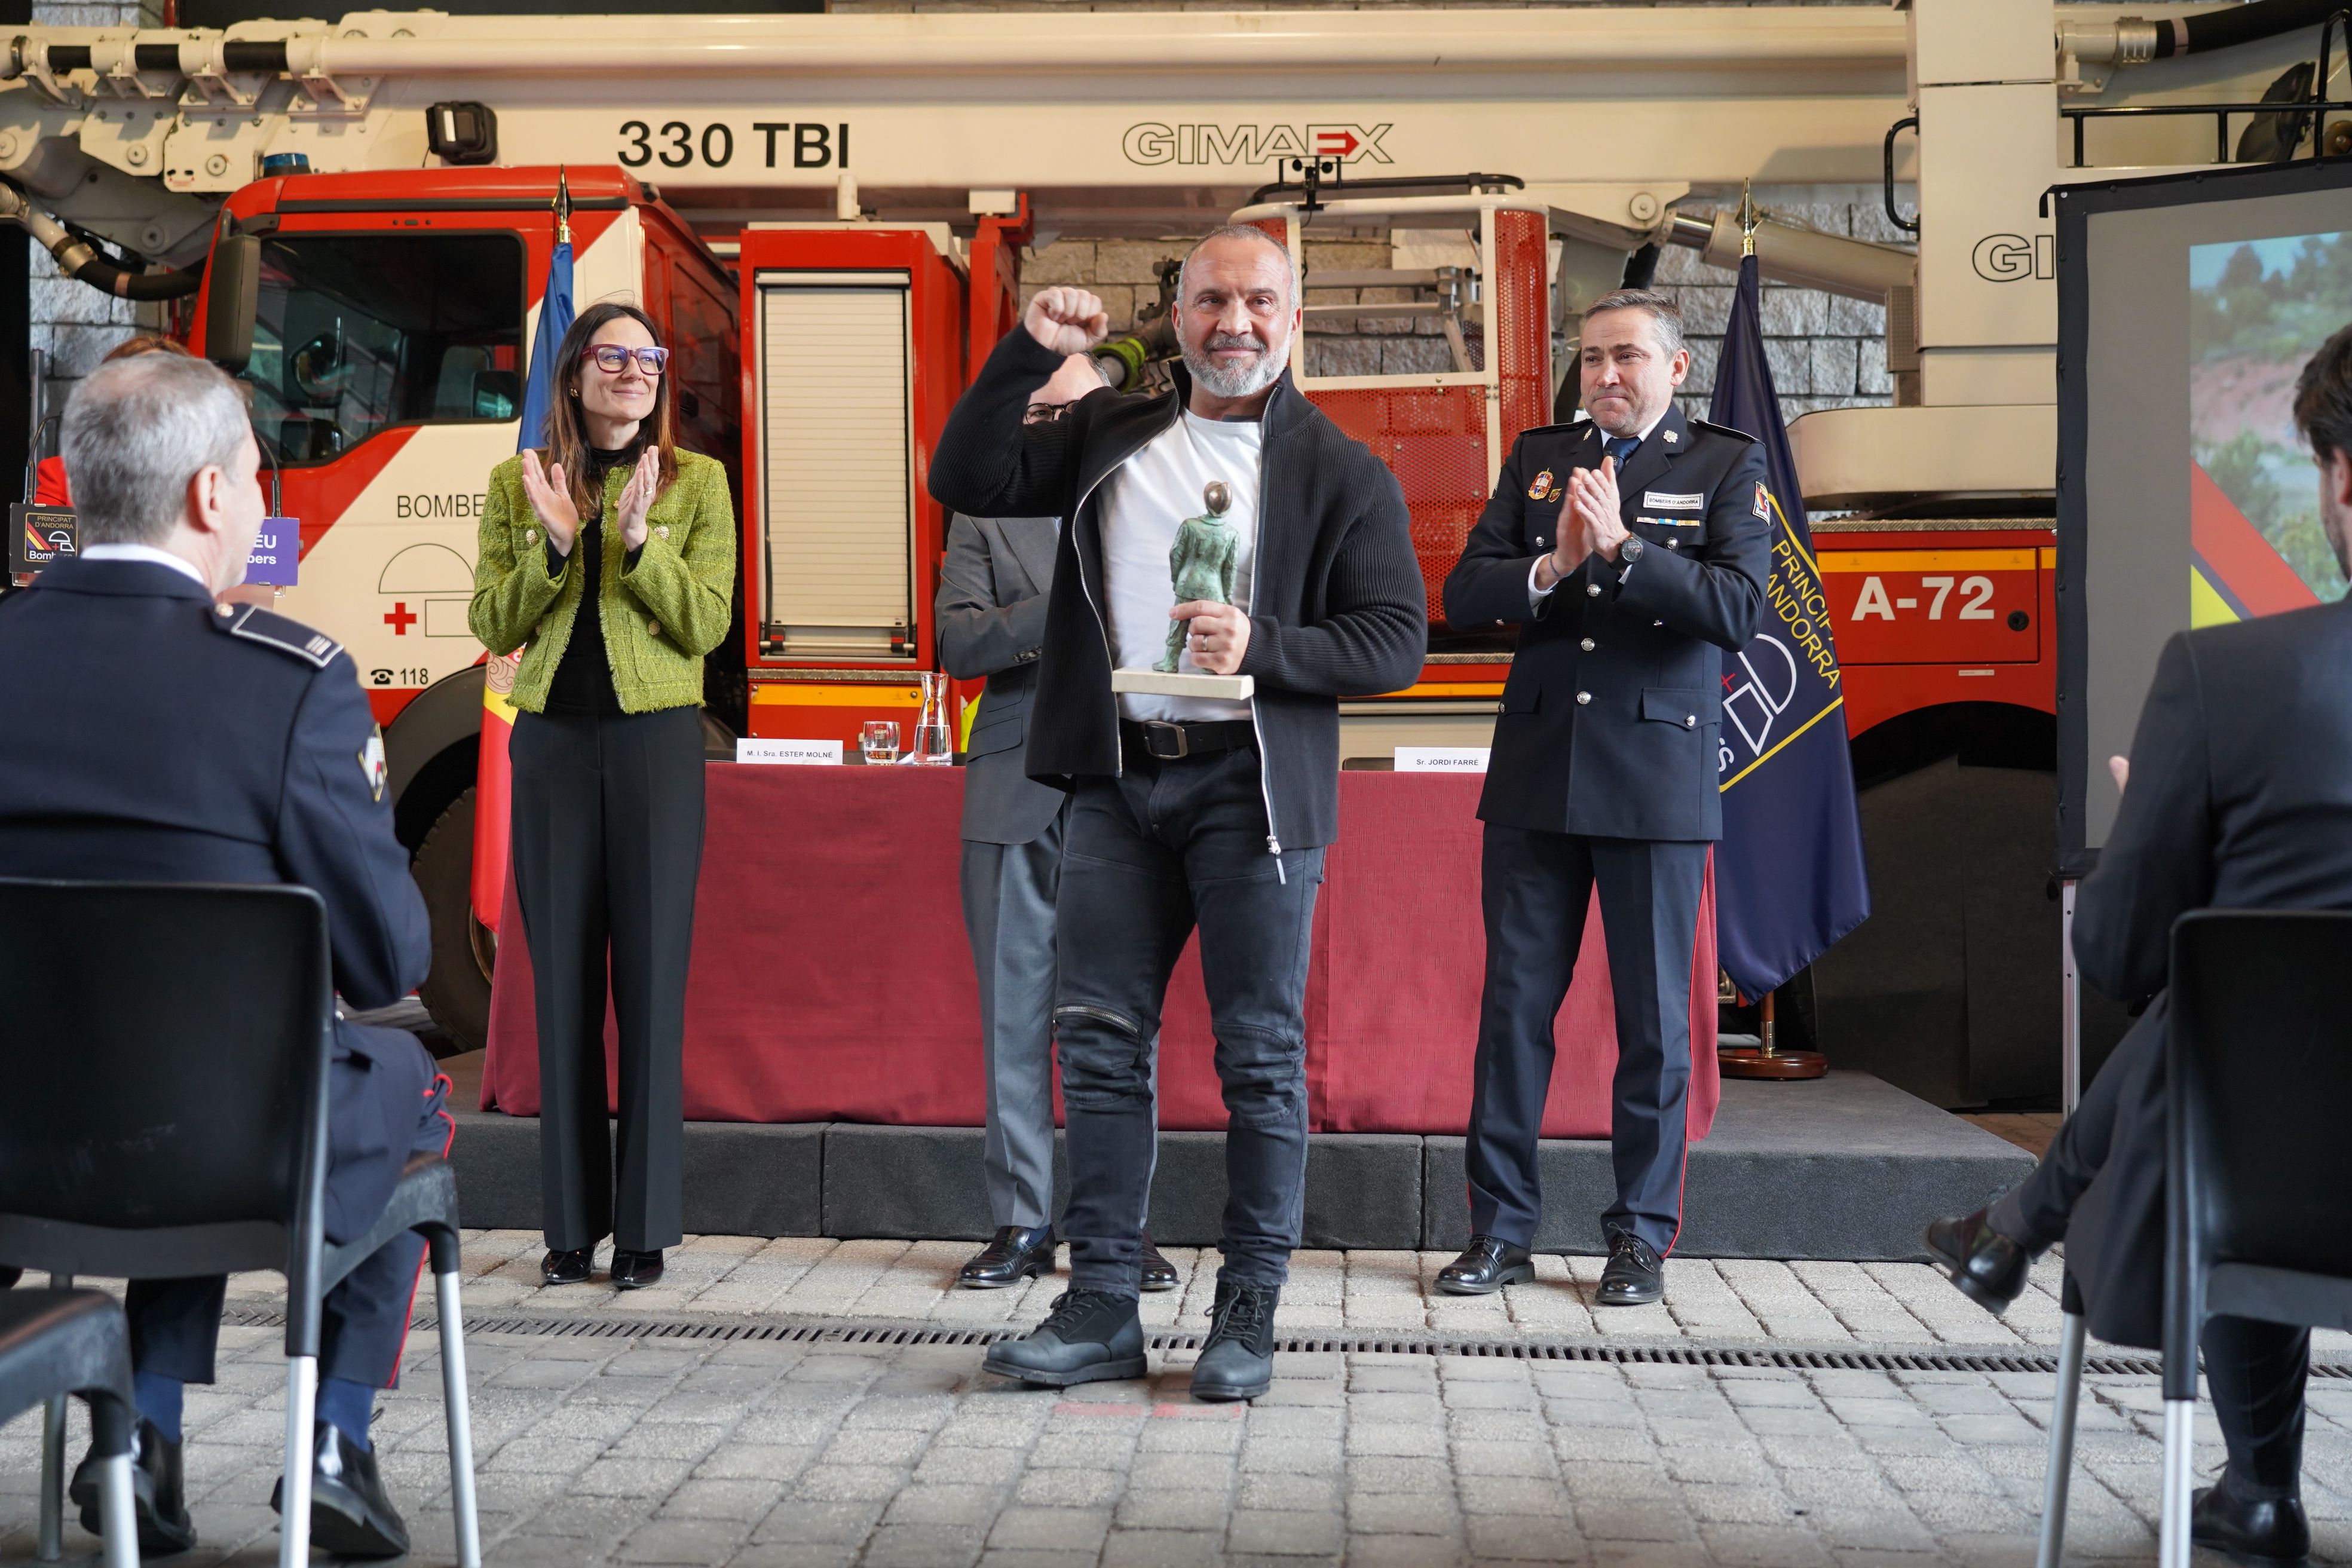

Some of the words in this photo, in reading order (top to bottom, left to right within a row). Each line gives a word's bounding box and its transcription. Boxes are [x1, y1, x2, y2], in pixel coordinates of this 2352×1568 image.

[617, 121, 734, 168] 330
[753, 123, 849, 169] TBI
[1122, 122, 1395, 166] GIMAEX
[1851, 575, 1995, 621] A-72
[400, 668, 428, 685] 118
